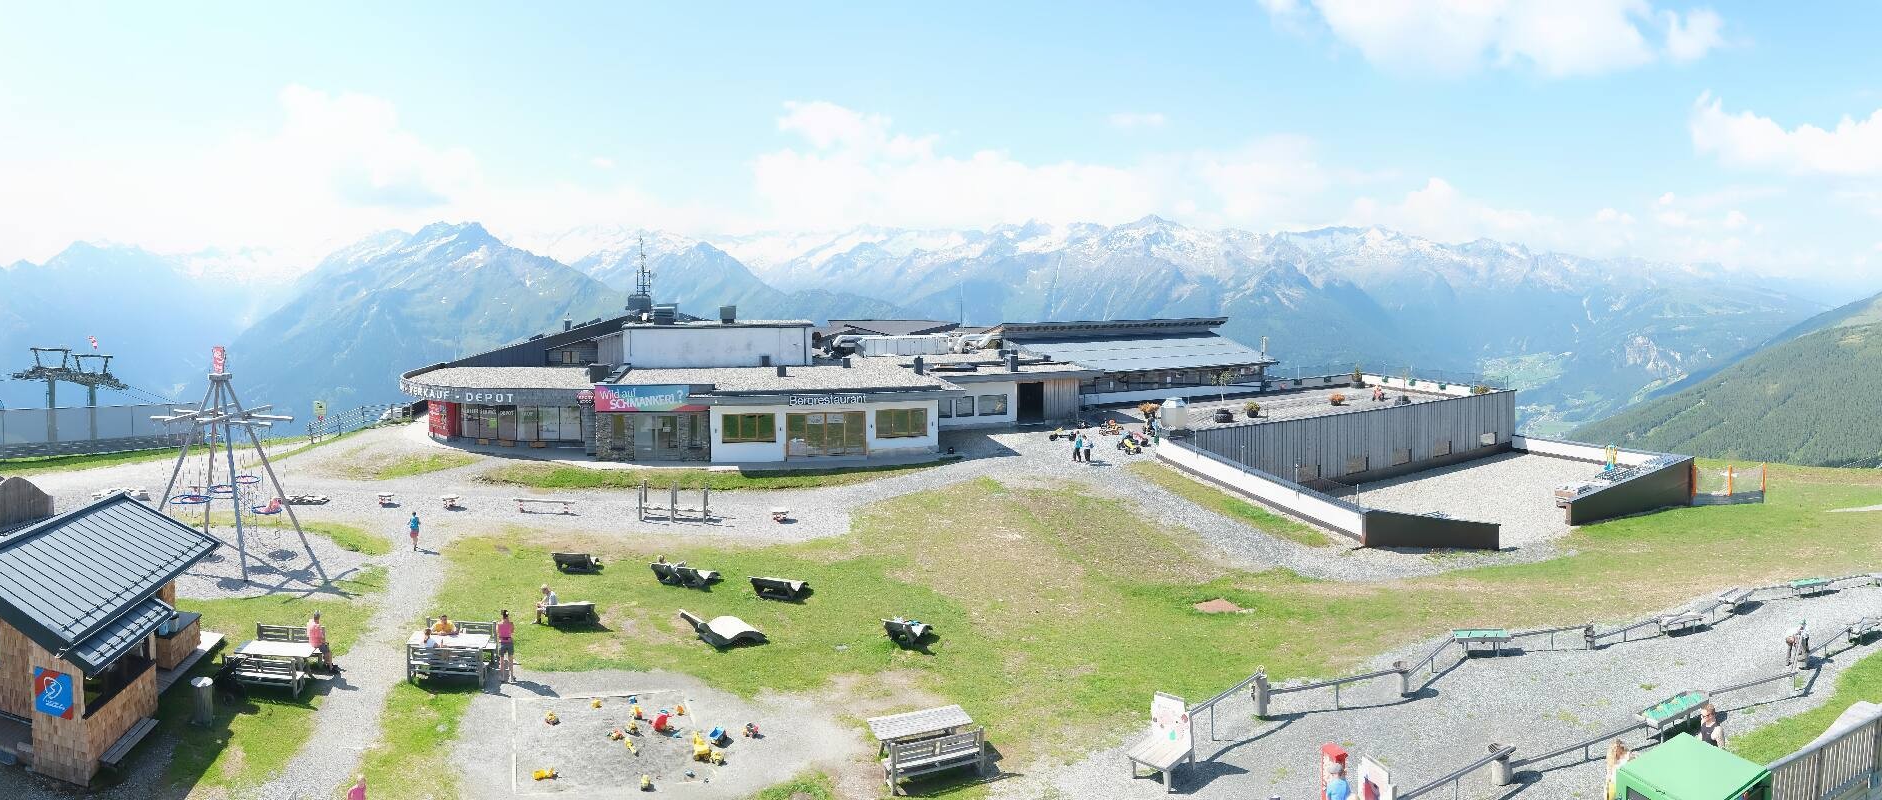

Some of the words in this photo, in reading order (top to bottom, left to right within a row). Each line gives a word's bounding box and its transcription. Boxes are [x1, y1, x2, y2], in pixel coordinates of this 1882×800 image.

[465, 392, 514, 402] DEPOT
[599, 388, 619, 400] Wild
[789, 393, 866, 406] Bergrestaurant
